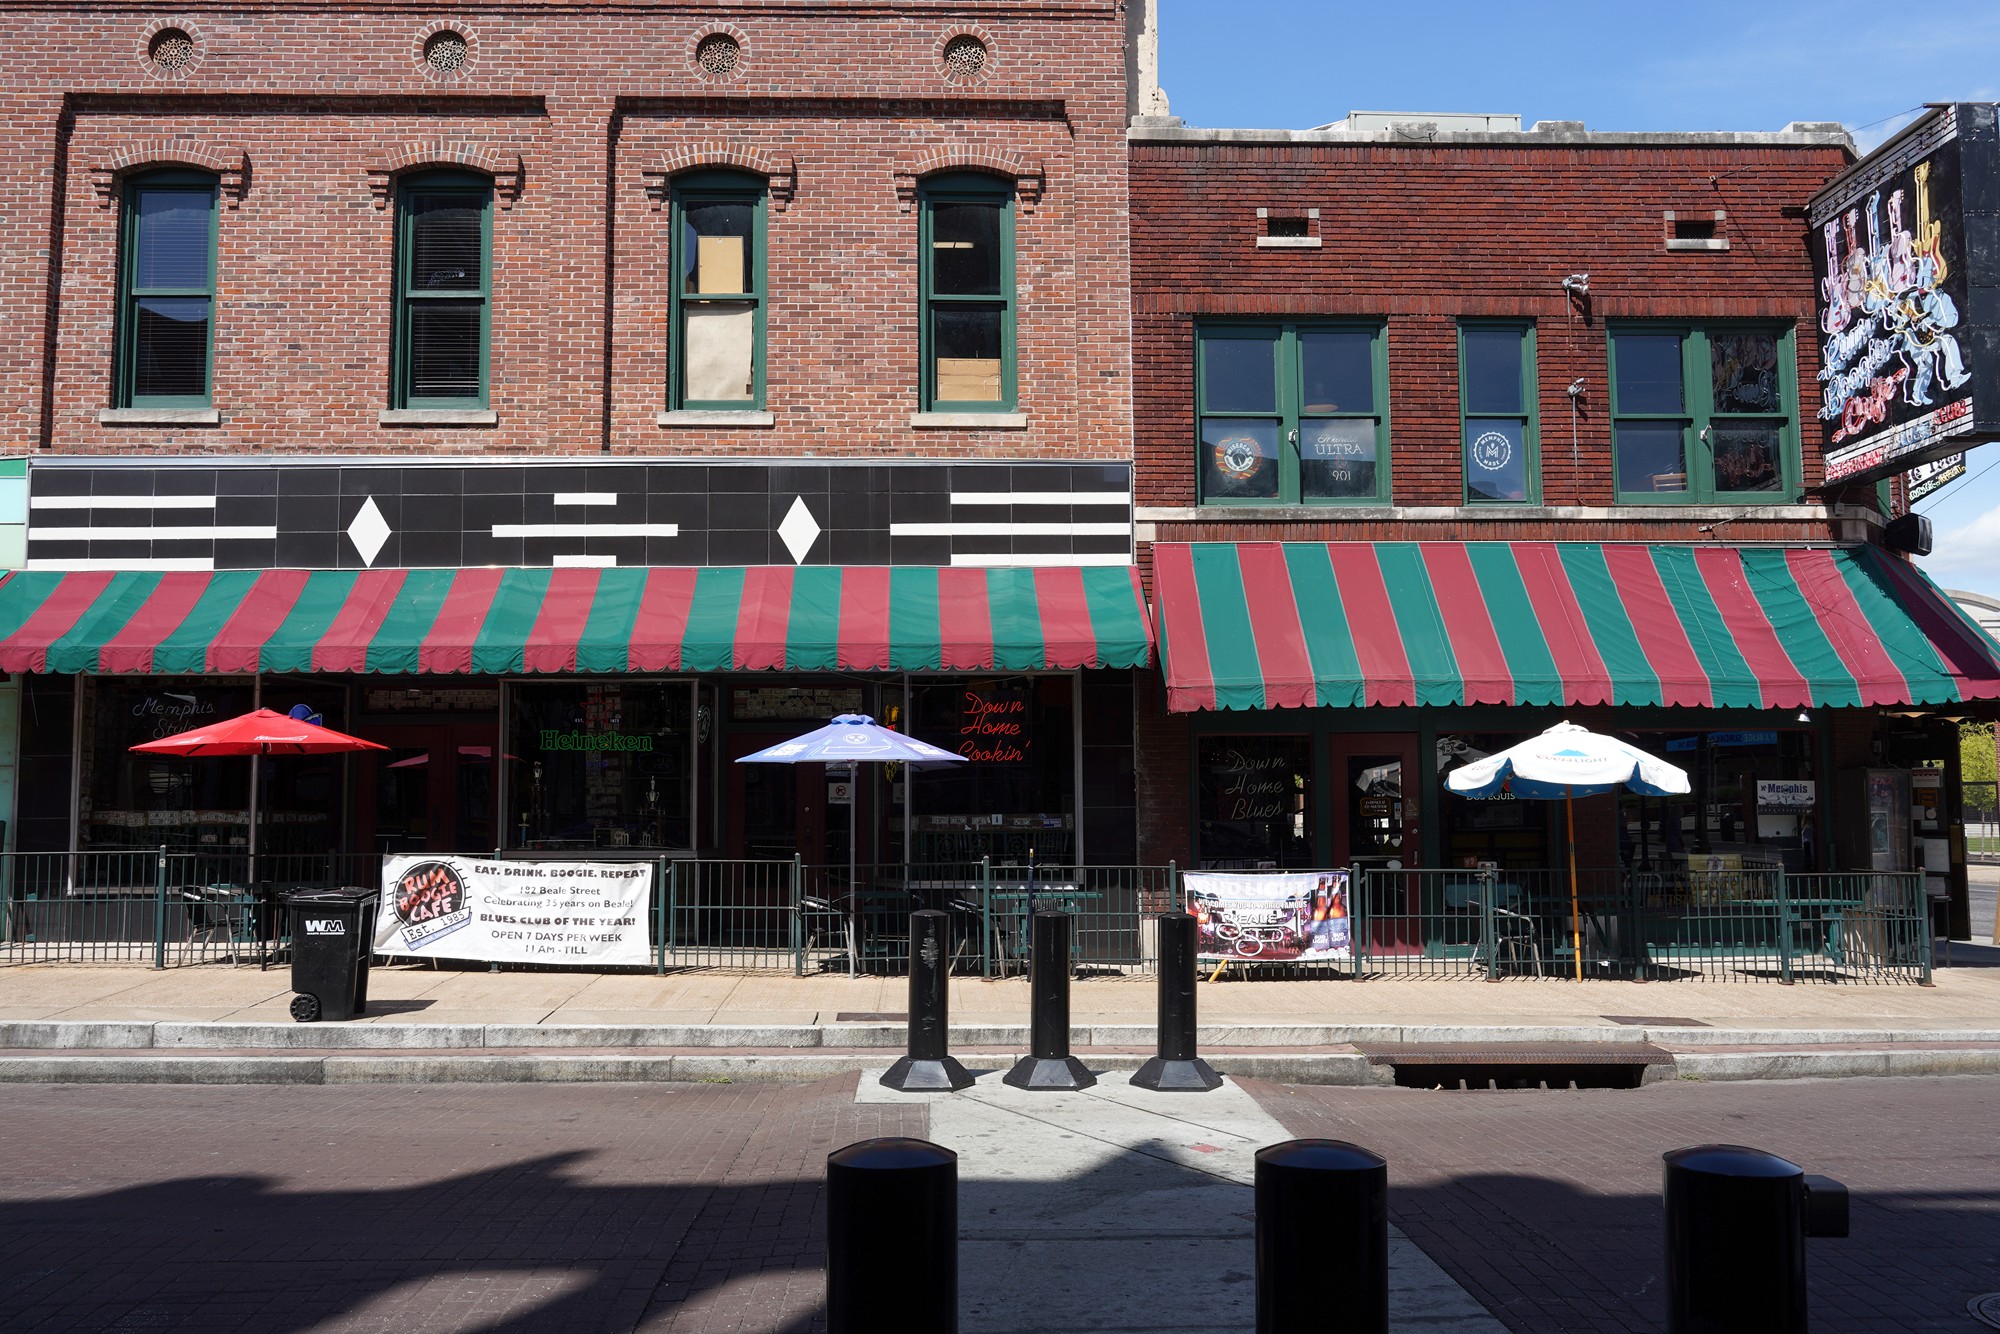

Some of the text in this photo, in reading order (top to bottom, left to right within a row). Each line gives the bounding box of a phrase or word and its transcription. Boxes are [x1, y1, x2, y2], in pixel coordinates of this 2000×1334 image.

[1314, 443, 1363, 455] ULTRA
[1480, 436, 1506, 447] MEMPHIS
[1483, 459, 1500, 467] MADE
[1332, 470, 1350, 481] 901
[132, 698, 214, 721] Memphis
[963, 692, 1025, 714] Down
[960, 712, 1021, 735] Home
[540, 730, 653, 751] Heineken
[958, 740, 1031, 761] Cookin'
[1227, 749, 1285, 772] Down
[1225, 773, 1285, 795] Home
[1231, 798, 1284, 820] Blues
[403, 868, 450, 894] RUM
[475, 865, 646, 879] EAT. DRINK. BOOGIE. REPEAT
[400, 881, 457, 911] BOOGIE
[539, 887, 567, 895] Beale
[569, 887, 601, 895] Street
[411, 897, 451, 921] CAFE
[484, 896, 542, 909] Celebrating
[559, 900, 586, 910] years
[603, 899, 634, 908] Beale!
[305, 920, 346, 932] WM
[407, 911, 465, 940] Est. 1985
[480, 913, 636, 926] BLUES CLUB OF THE YEAR!
[491, 930, 622, 942] OPEN 7 DAYS PER WEEK
[564, 945, 588, 955] TILL
